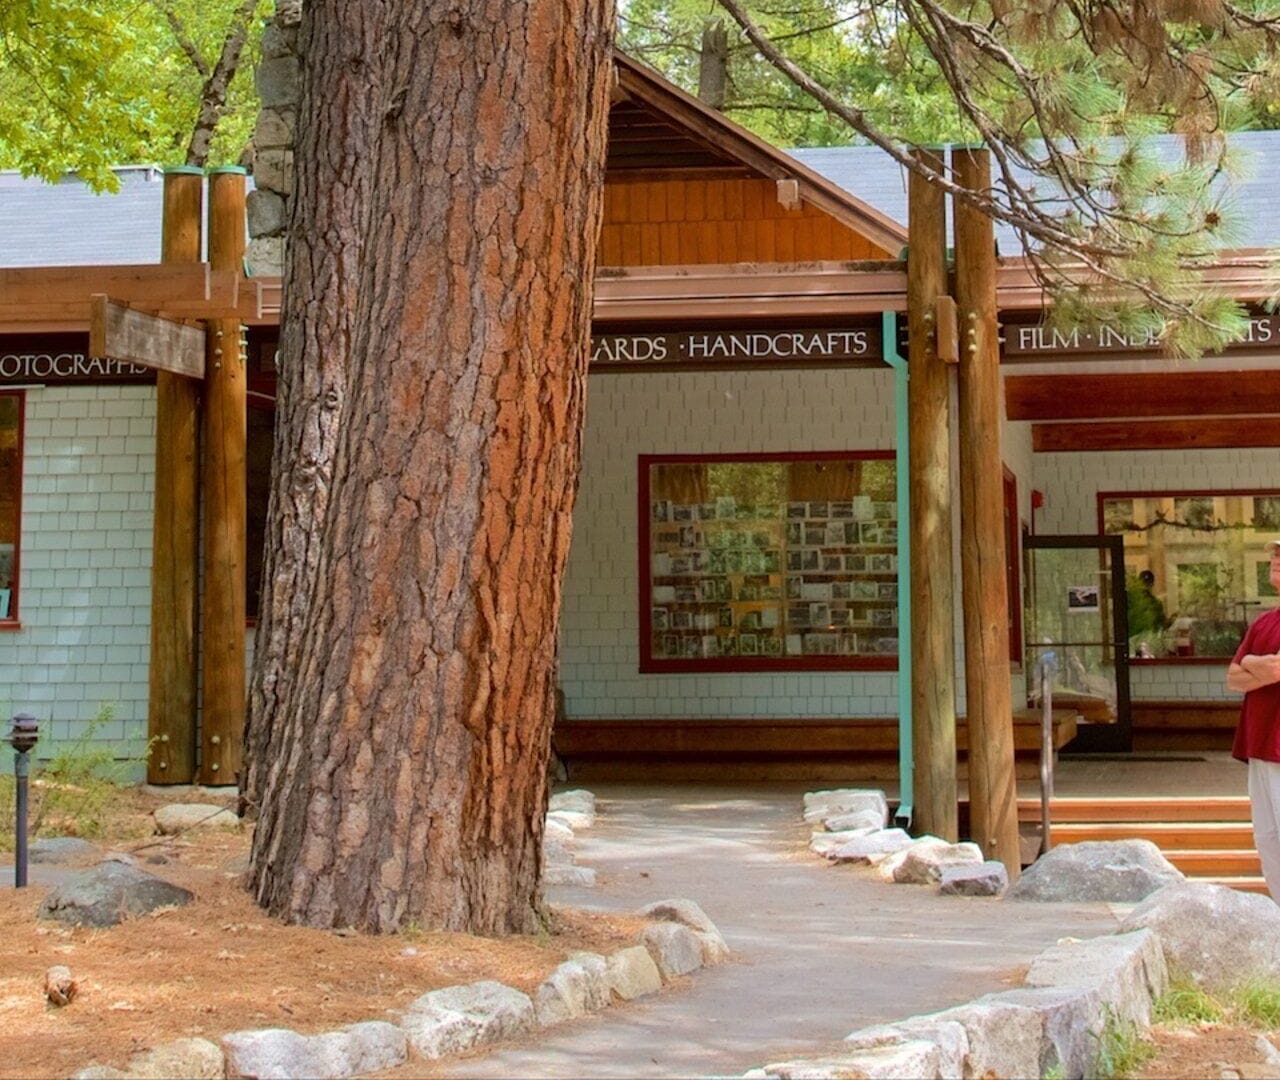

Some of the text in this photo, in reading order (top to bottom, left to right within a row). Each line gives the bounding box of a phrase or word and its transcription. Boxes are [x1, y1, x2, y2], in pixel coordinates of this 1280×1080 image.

[589, 332, 868, 361] ARDS HANDCRAFTS
[1019, 327, 1079, 349] FILM
